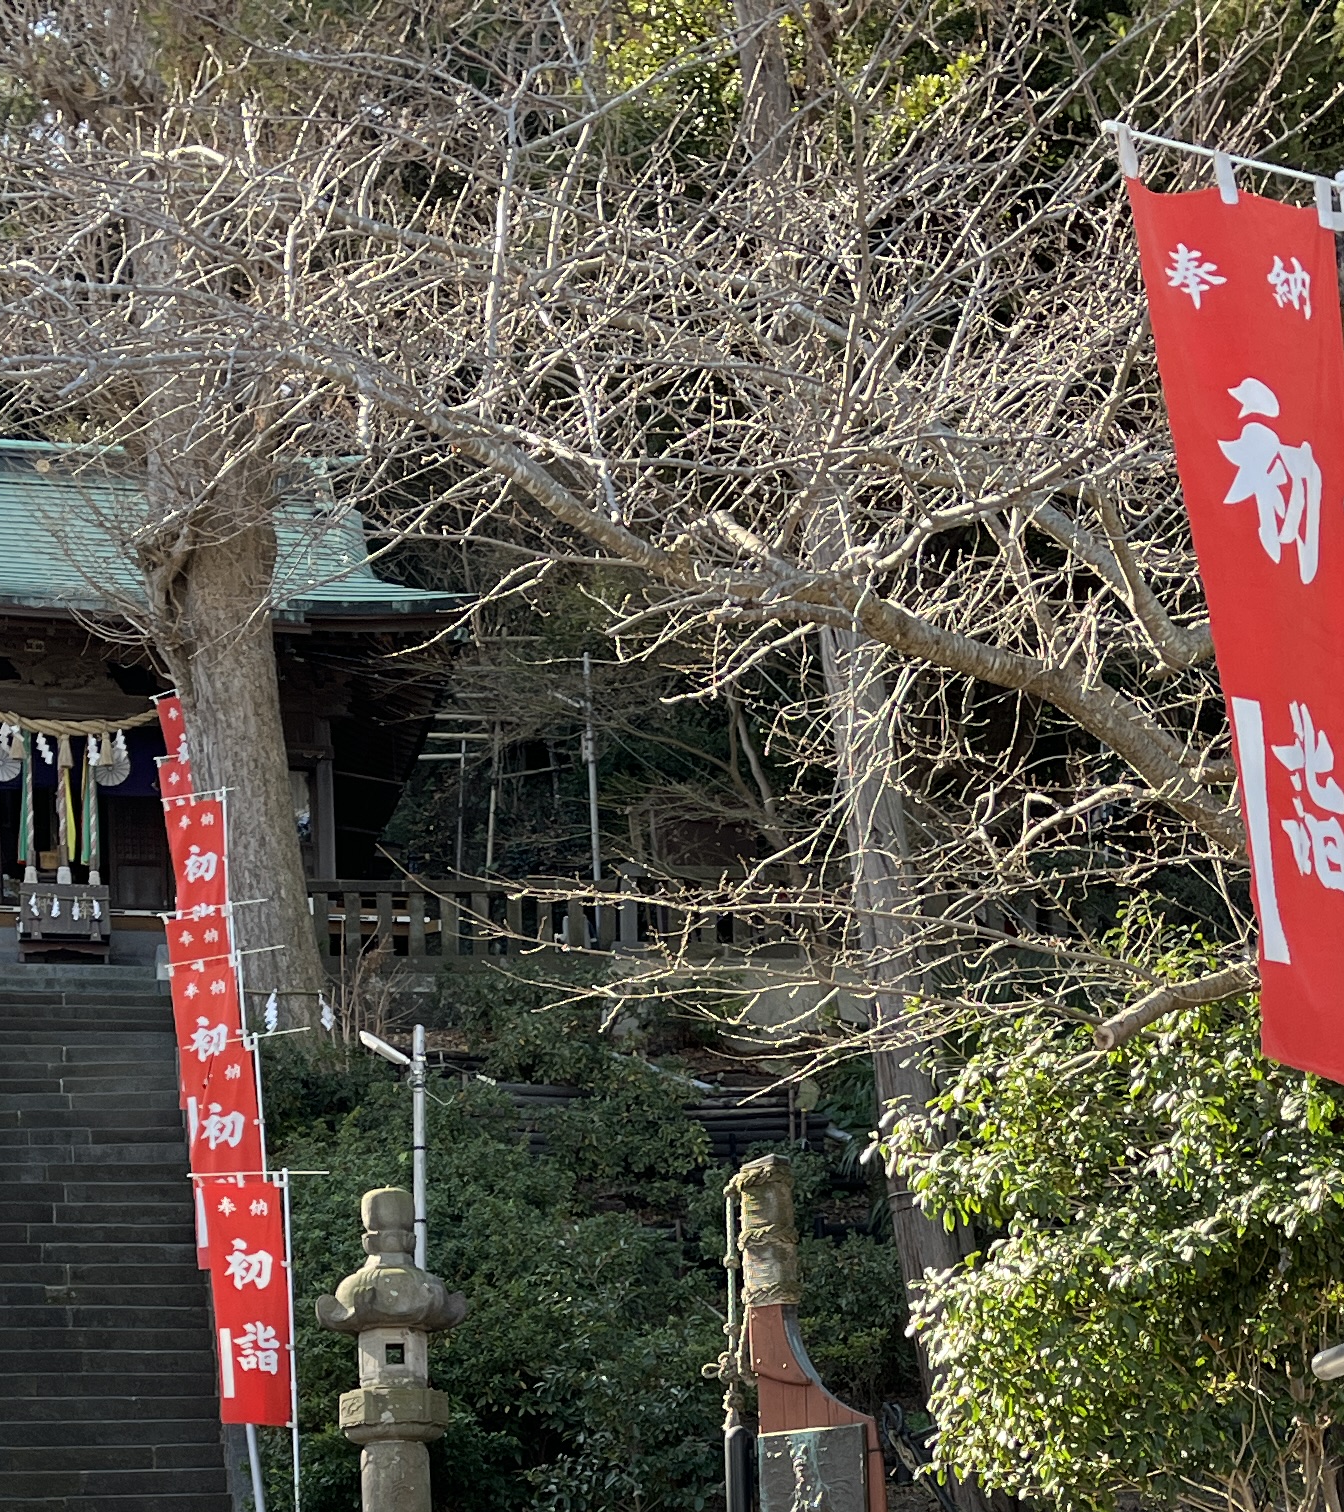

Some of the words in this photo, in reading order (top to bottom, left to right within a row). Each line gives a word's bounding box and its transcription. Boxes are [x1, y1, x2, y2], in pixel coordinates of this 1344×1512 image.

[1164, 242, 1312, 320] 奉納
[178, 928, 220, 947] 奉納
[183, 978, 227, 999] 奉納
[217, 1196, 269, 1217] 奉納
[223, 1237, 281, 1375] 初詣
